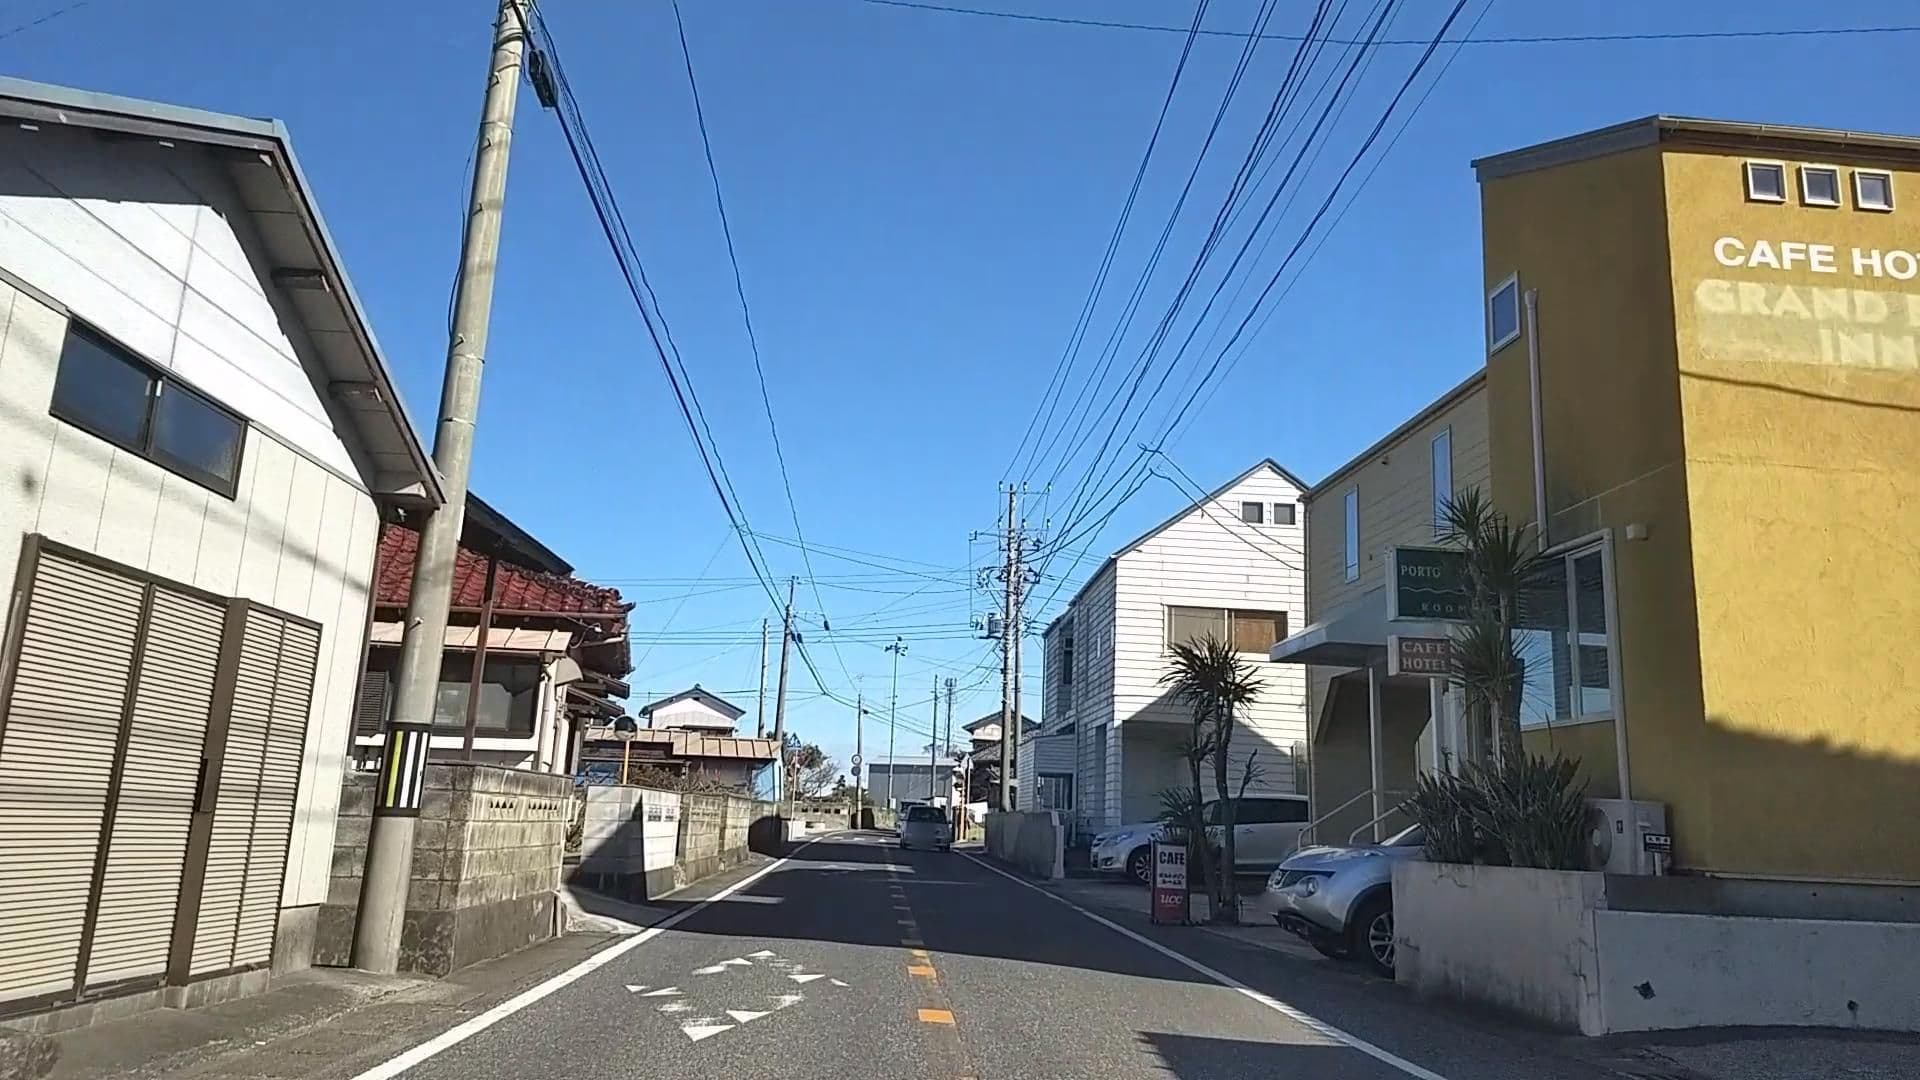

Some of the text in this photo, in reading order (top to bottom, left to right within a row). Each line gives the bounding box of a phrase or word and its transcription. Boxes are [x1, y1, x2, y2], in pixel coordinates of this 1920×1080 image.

[1713, 236, 1920, 281] CAFE HO
[1695, 279, 1888, 324] GRAND
[1401, 565, 1441, 578] PORTO
[1402, 642, 1446, 654] CAFE
[1402, 657, 1447, 671] HOTEL
[1160, 851, 1185, 864] CAFE
